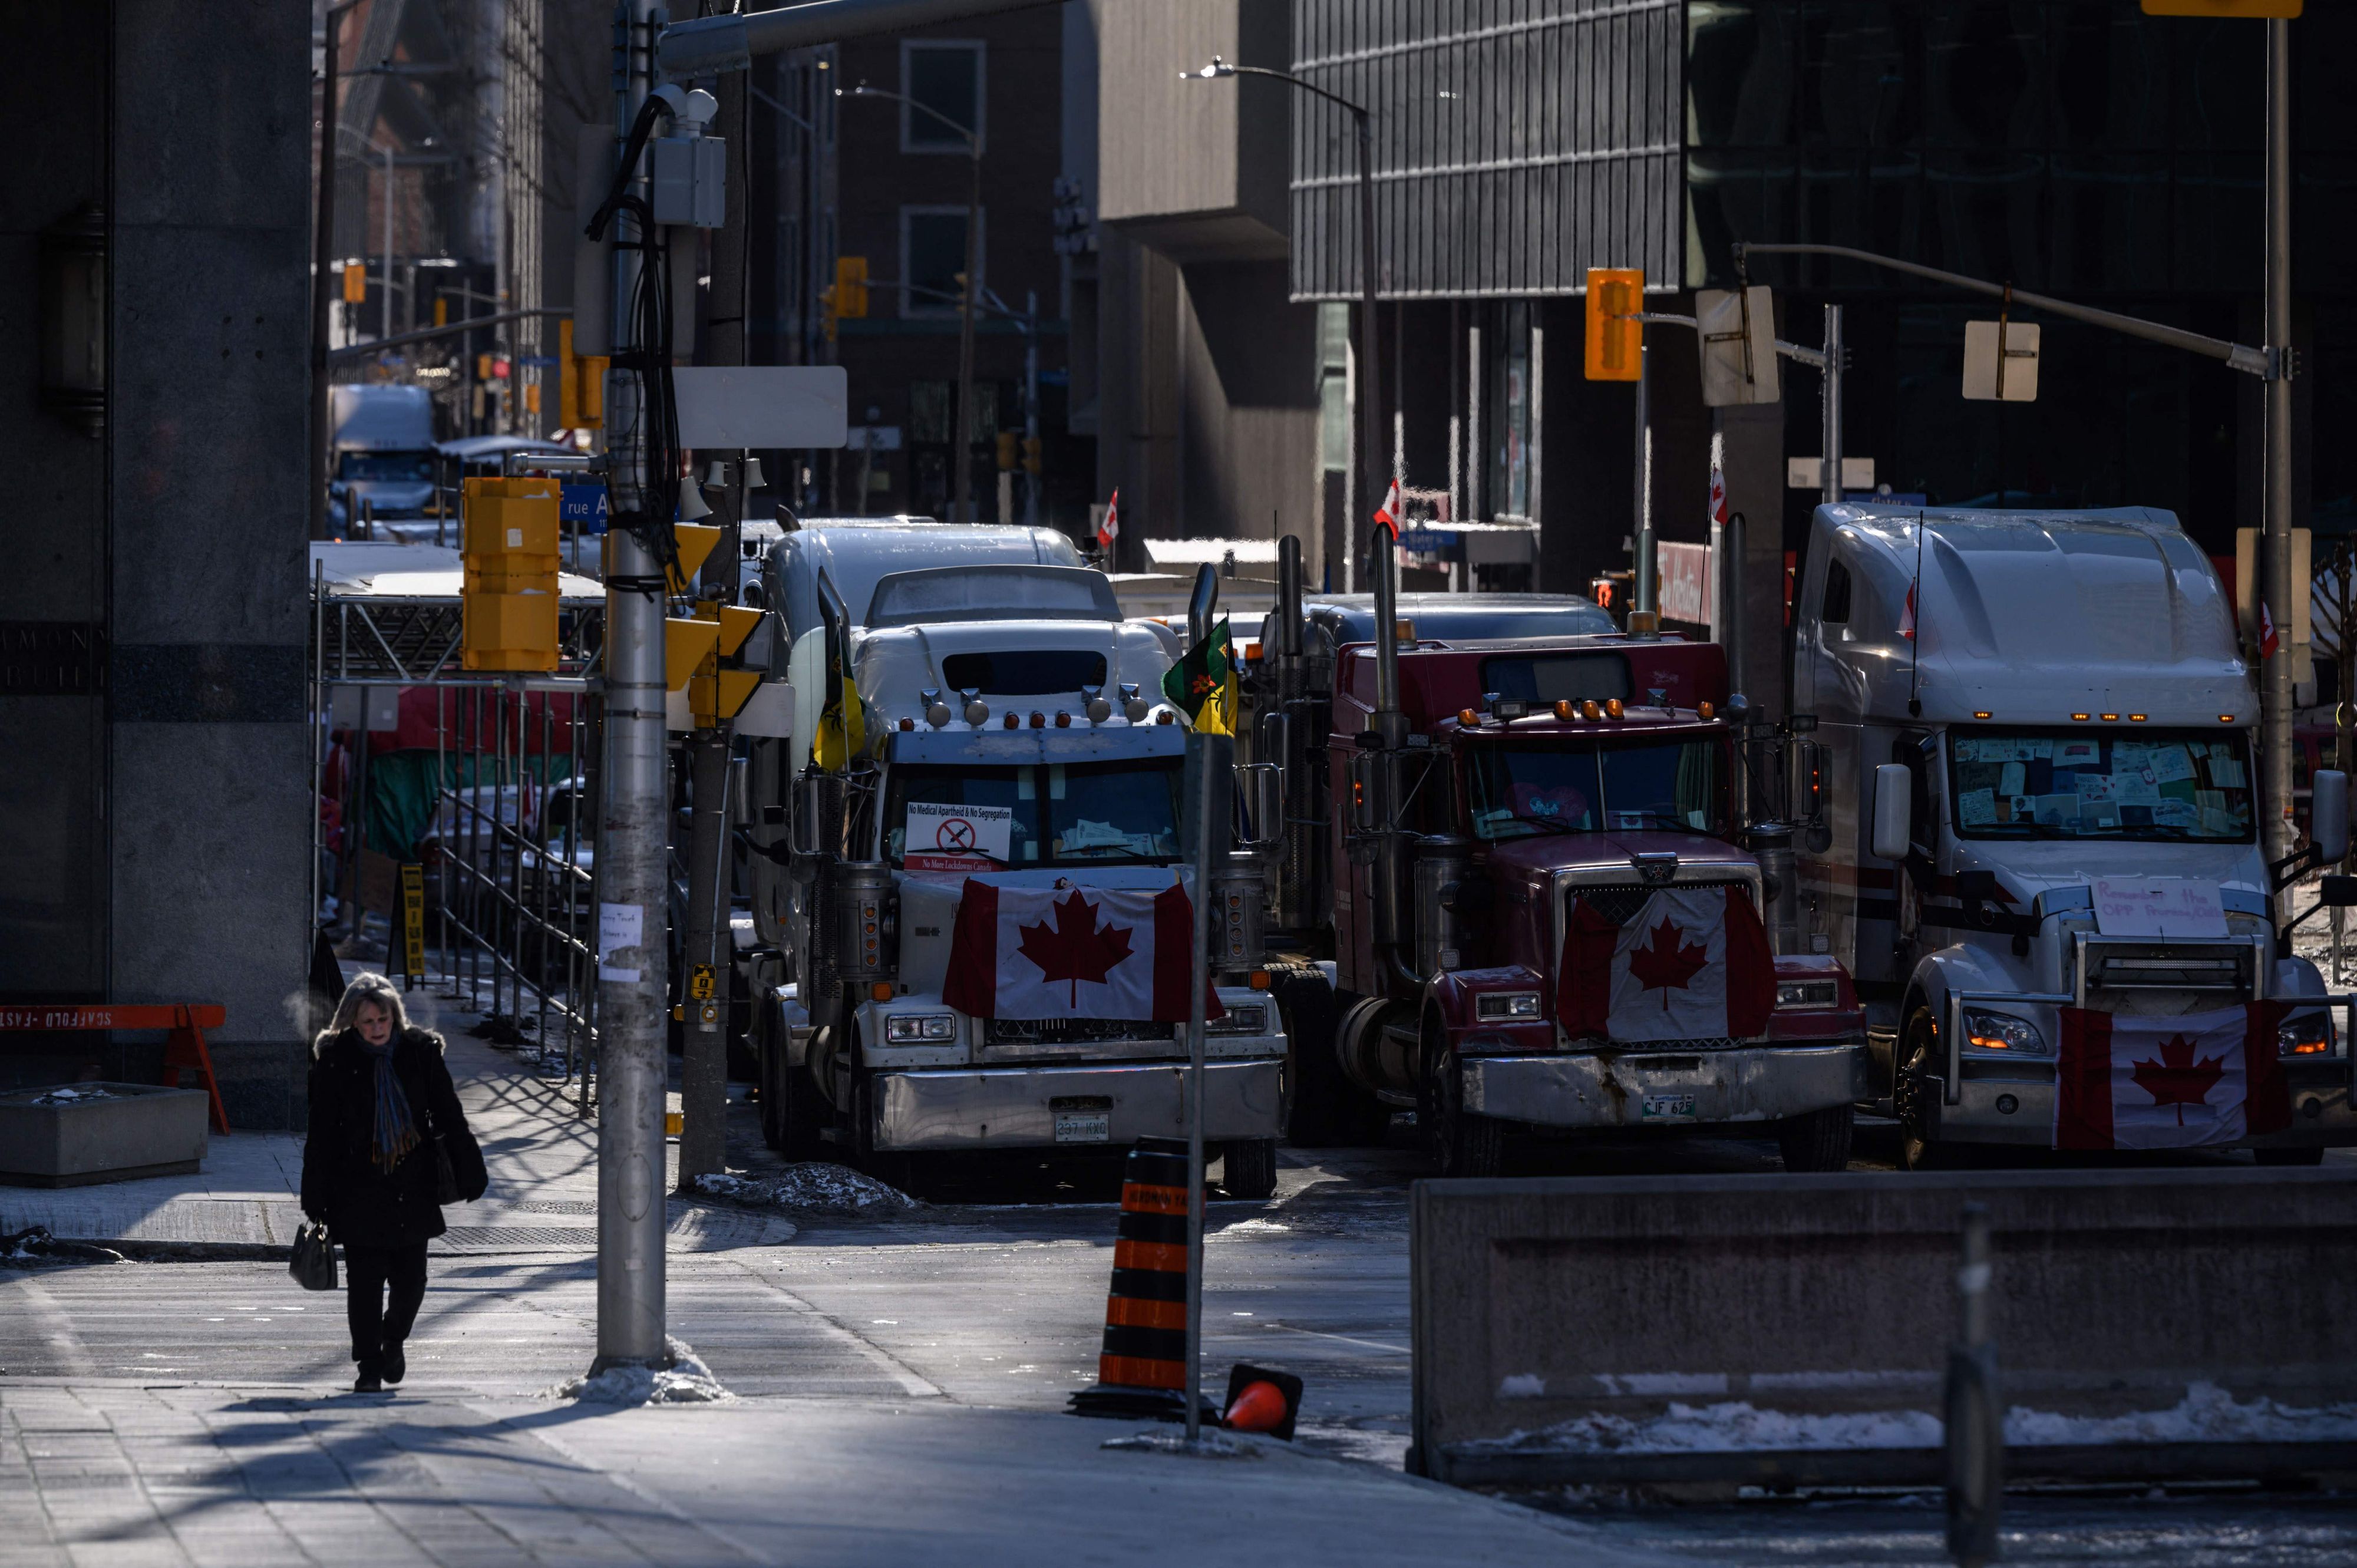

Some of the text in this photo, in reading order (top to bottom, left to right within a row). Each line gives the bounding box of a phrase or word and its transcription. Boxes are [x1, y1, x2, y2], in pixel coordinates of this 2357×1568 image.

[569, 504, 589, 514] rue
[909, 804, 1010, 821] No Medical Apartheid & No Segregation
[923, 859, 992, 872] No More Lockdowns Canada
[2182, 888, 2207, 903] the
[2102, 904, 2133, 916] OPP
[47, 1012, 111, 1028] SCAFFOLD
[1645, 1102, 1692, 1115] CJF 625
[1058, 1122, 1107, 1135] 237 KXQ
